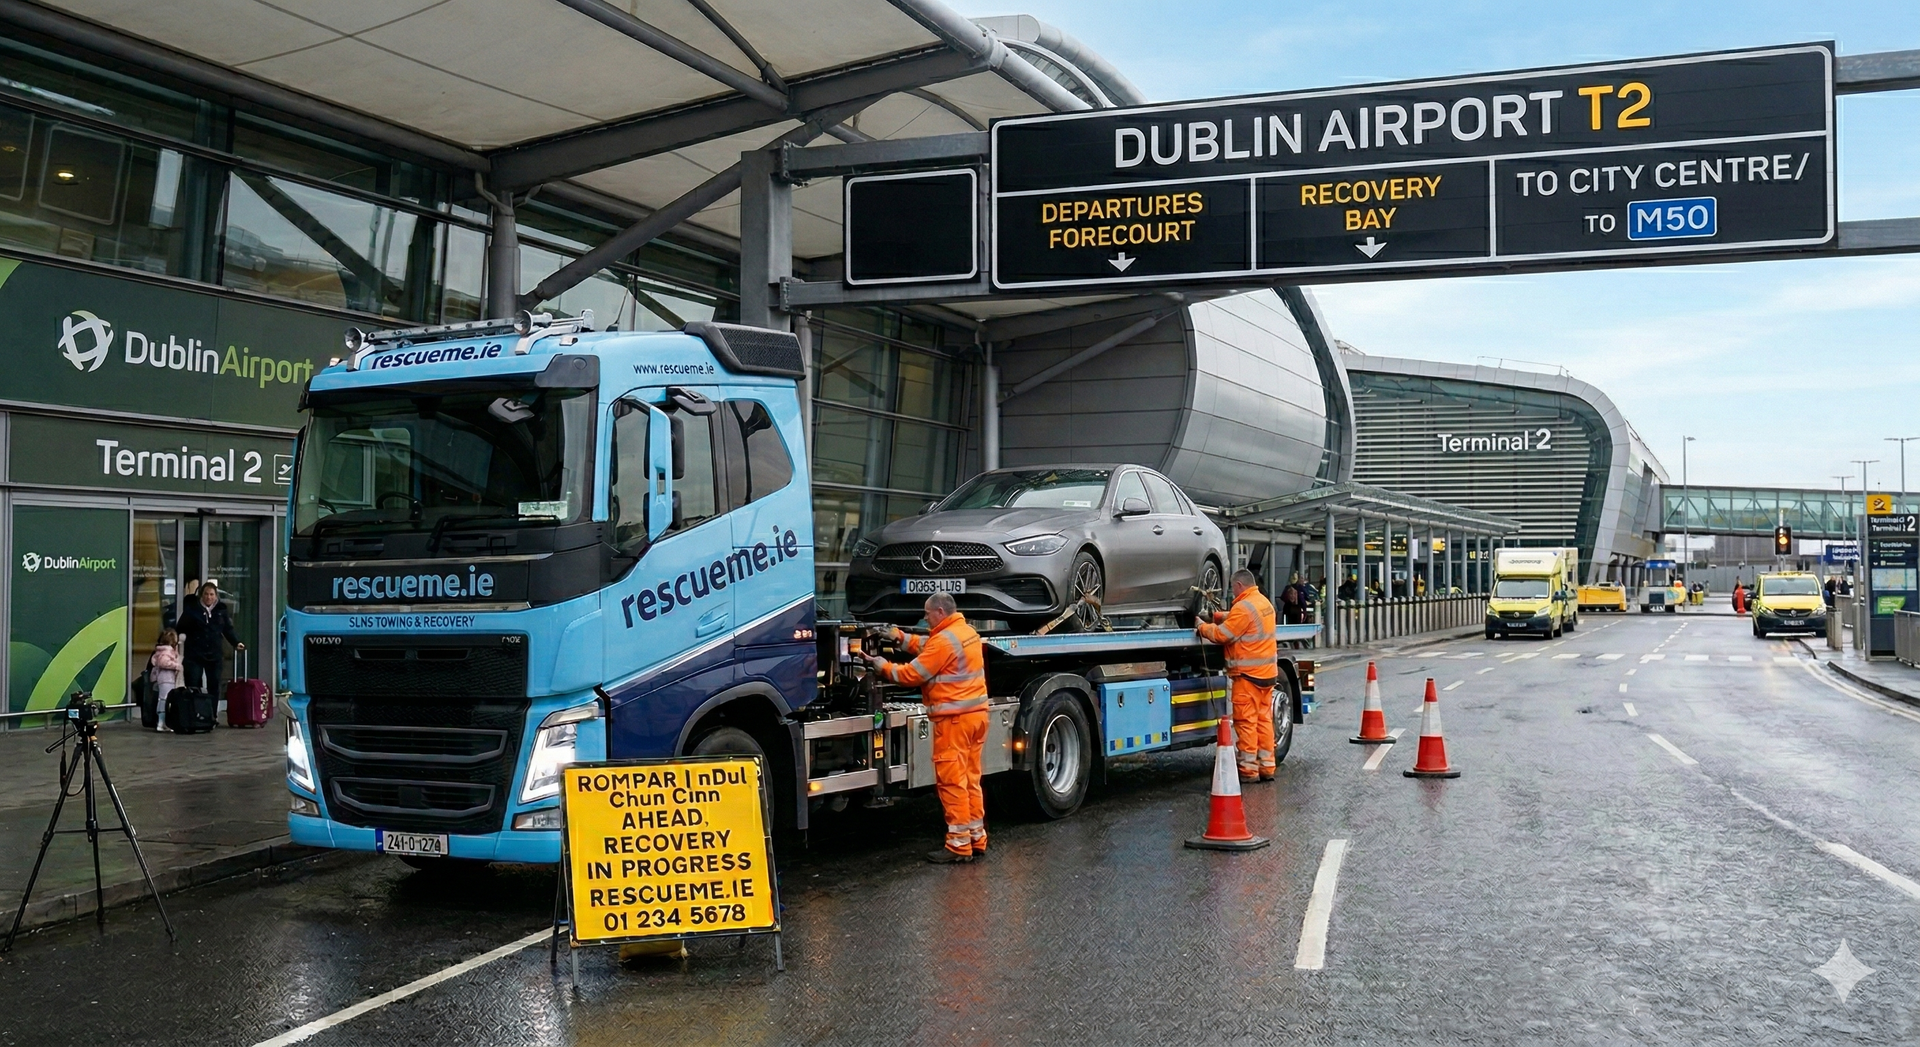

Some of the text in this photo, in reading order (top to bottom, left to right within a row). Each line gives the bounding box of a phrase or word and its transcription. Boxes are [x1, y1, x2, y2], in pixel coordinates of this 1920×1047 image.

[1114, 81, 1652, 168] DUBLIN AIRPORT T2
[1517, 152, 1811, 198] TO CITY CENTRE/
[1300, 174, 1442, 206] RECOVERY
[1041, 191, 1204, 224] DEPARTURES
[1345, 207, 1397, 231] BAY
[1585, 204, 1709, 234] TO M50
[1049, 219, 1196, 250] FORECOURT
[372, 341, 502, 369] rescueme.ie
[633, 361, 714, 375] www.rescueme.ie
[1437, 428, 1551, 452] Terminal 2
[96, 439, 263, 483] Terminal 2
[44, 556, 116, 572] DublinAirport
[620, 524, 799, 628] rescueme.ie
[332, 565, 494, 599] rescueme.ie
[349, 615, 476, 628] SLNS TOWING & RECOVERY
[308, 636, 342, 645] VOLVO
[577, 771, 677, 793] ROMPAR
[609, 791, 665, 808] Chun
[622, 808, 710, 830] AHEAD,
[604, 829, 731, 854] RECOVERY
[587, 852, 751, 880] IN PROGRESS
[590, 878, 754, 907] RESCUEME.IE
[604, 903, 746, 931] 01 234 5678
